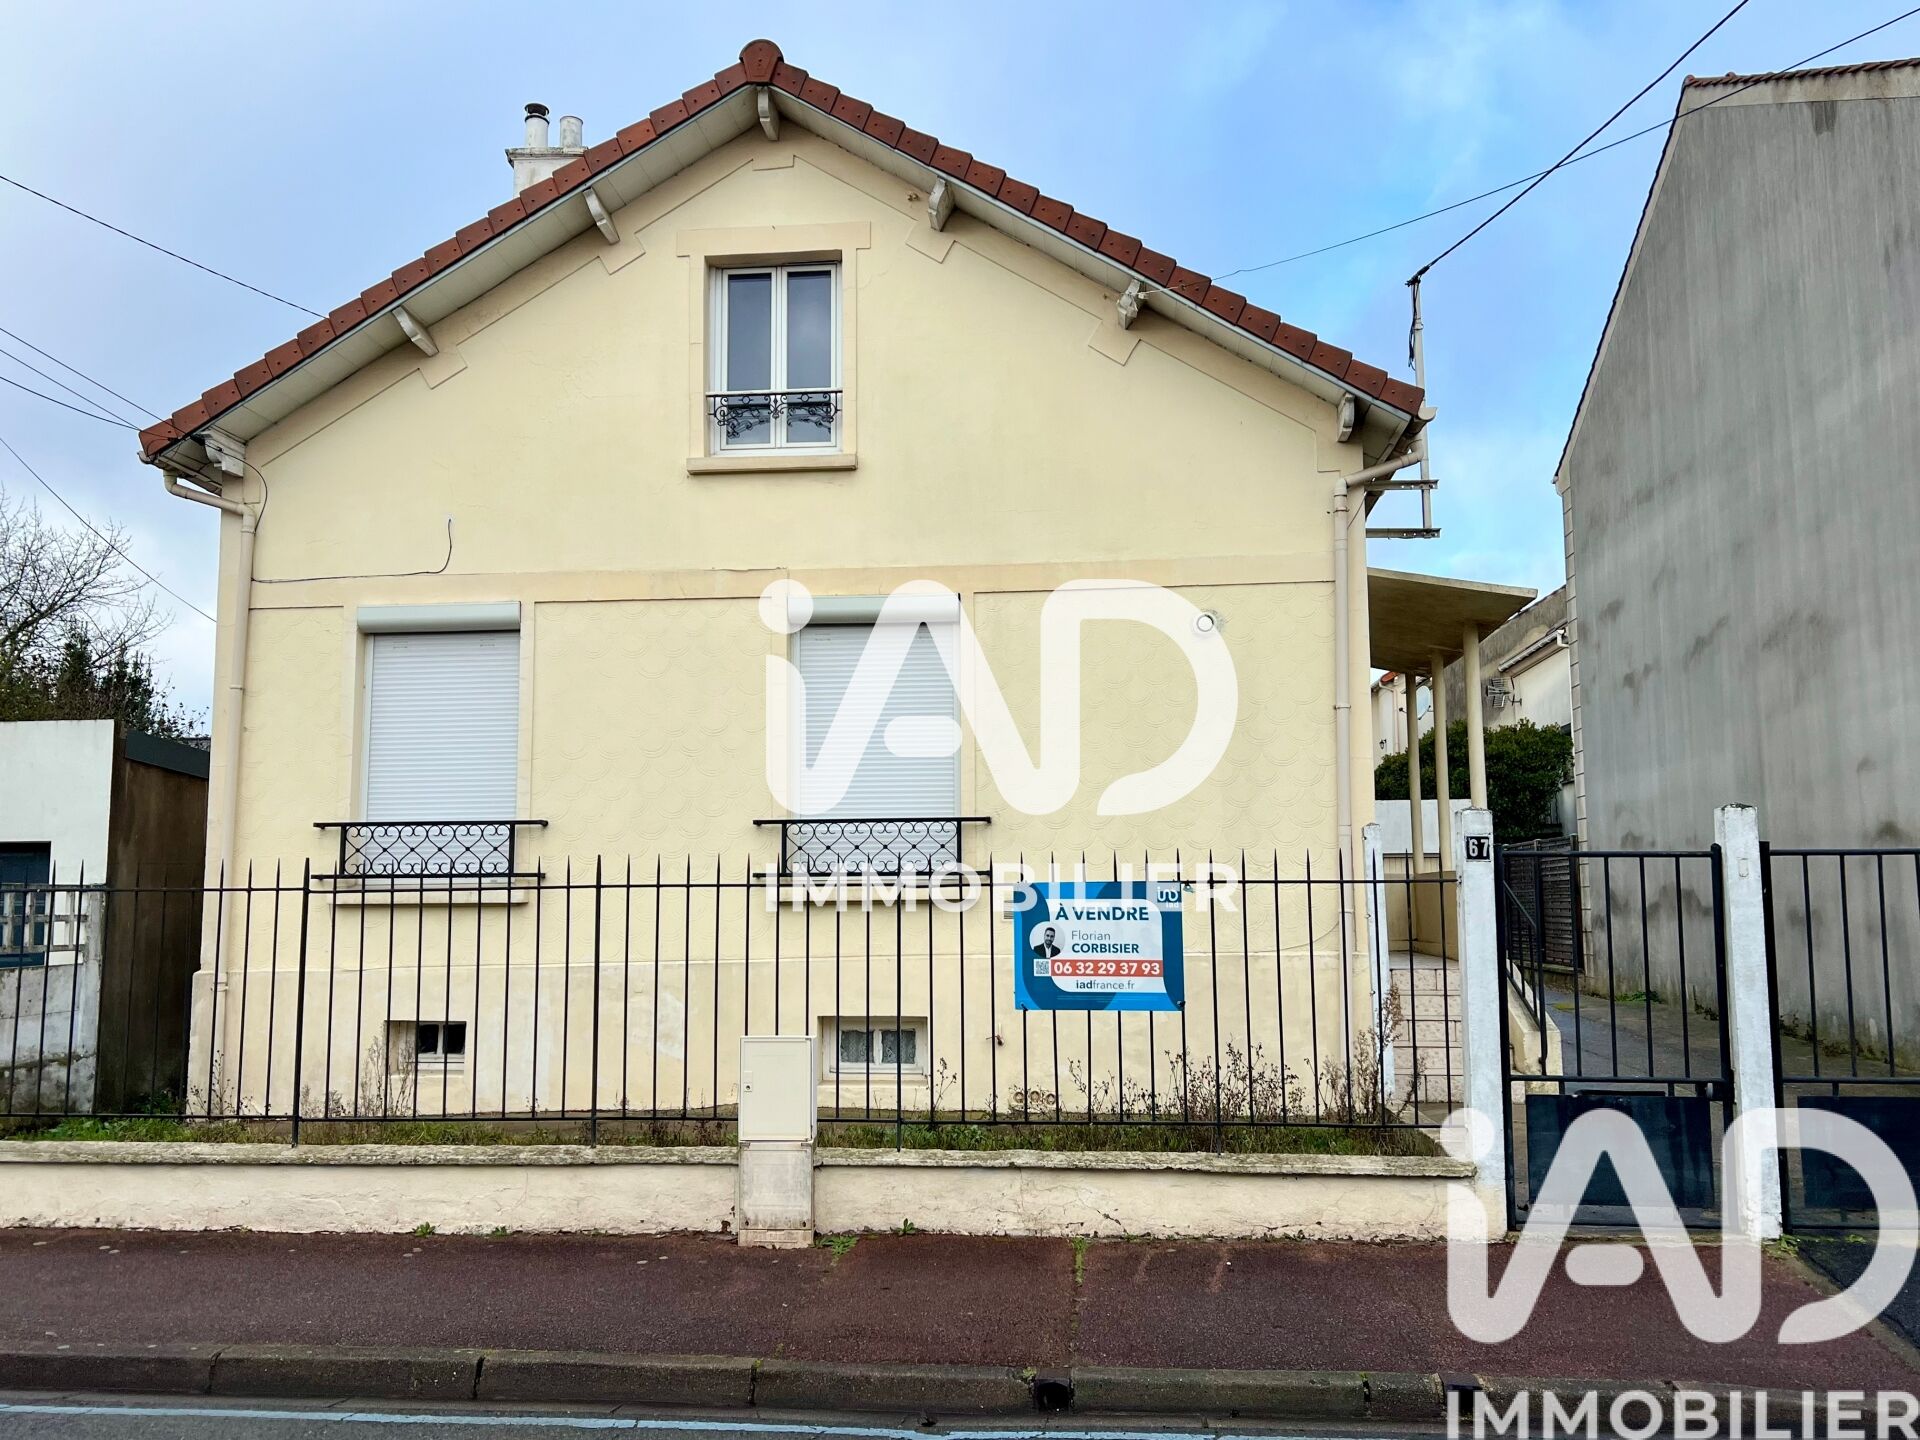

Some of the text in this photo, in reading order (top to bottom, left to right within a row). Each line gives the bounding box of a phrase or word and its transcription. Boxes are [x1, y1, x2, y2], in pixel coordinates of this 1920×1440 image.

[1468, 838, 1489, 857] 67
[1055, 903, 1149, 921] À VENDRE
[1071, 930, 1111, 941] Florian
[1071, 943, 1140, 954] CORBISIER
[1053, 961, 1160, 975] 06 32 29 37 93
[1075, 980, 1136, 990] iadfrance.fr
